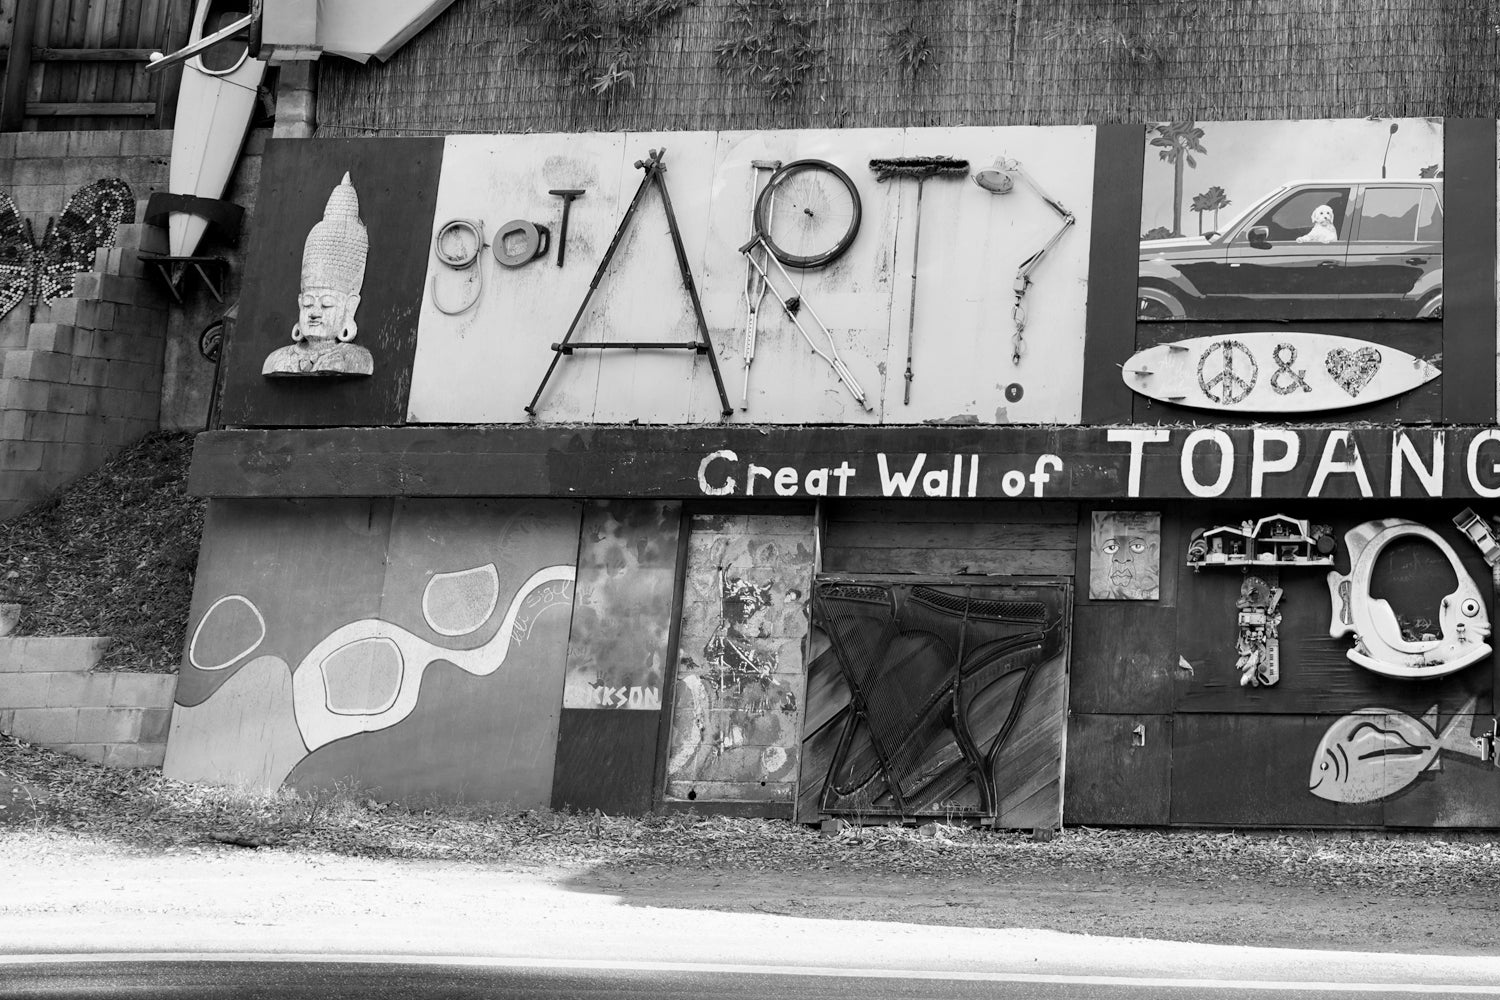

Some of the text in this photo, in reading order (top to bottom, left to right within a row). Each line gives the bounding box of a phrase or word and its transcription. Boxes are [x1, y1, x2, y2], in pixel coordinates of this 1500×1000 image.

[1270, 342, 1313, 396] &
[698, 449, 855, 497] Great
[877, 453, 978, 498] Wall
[1002, 454, 1064, 497] of
